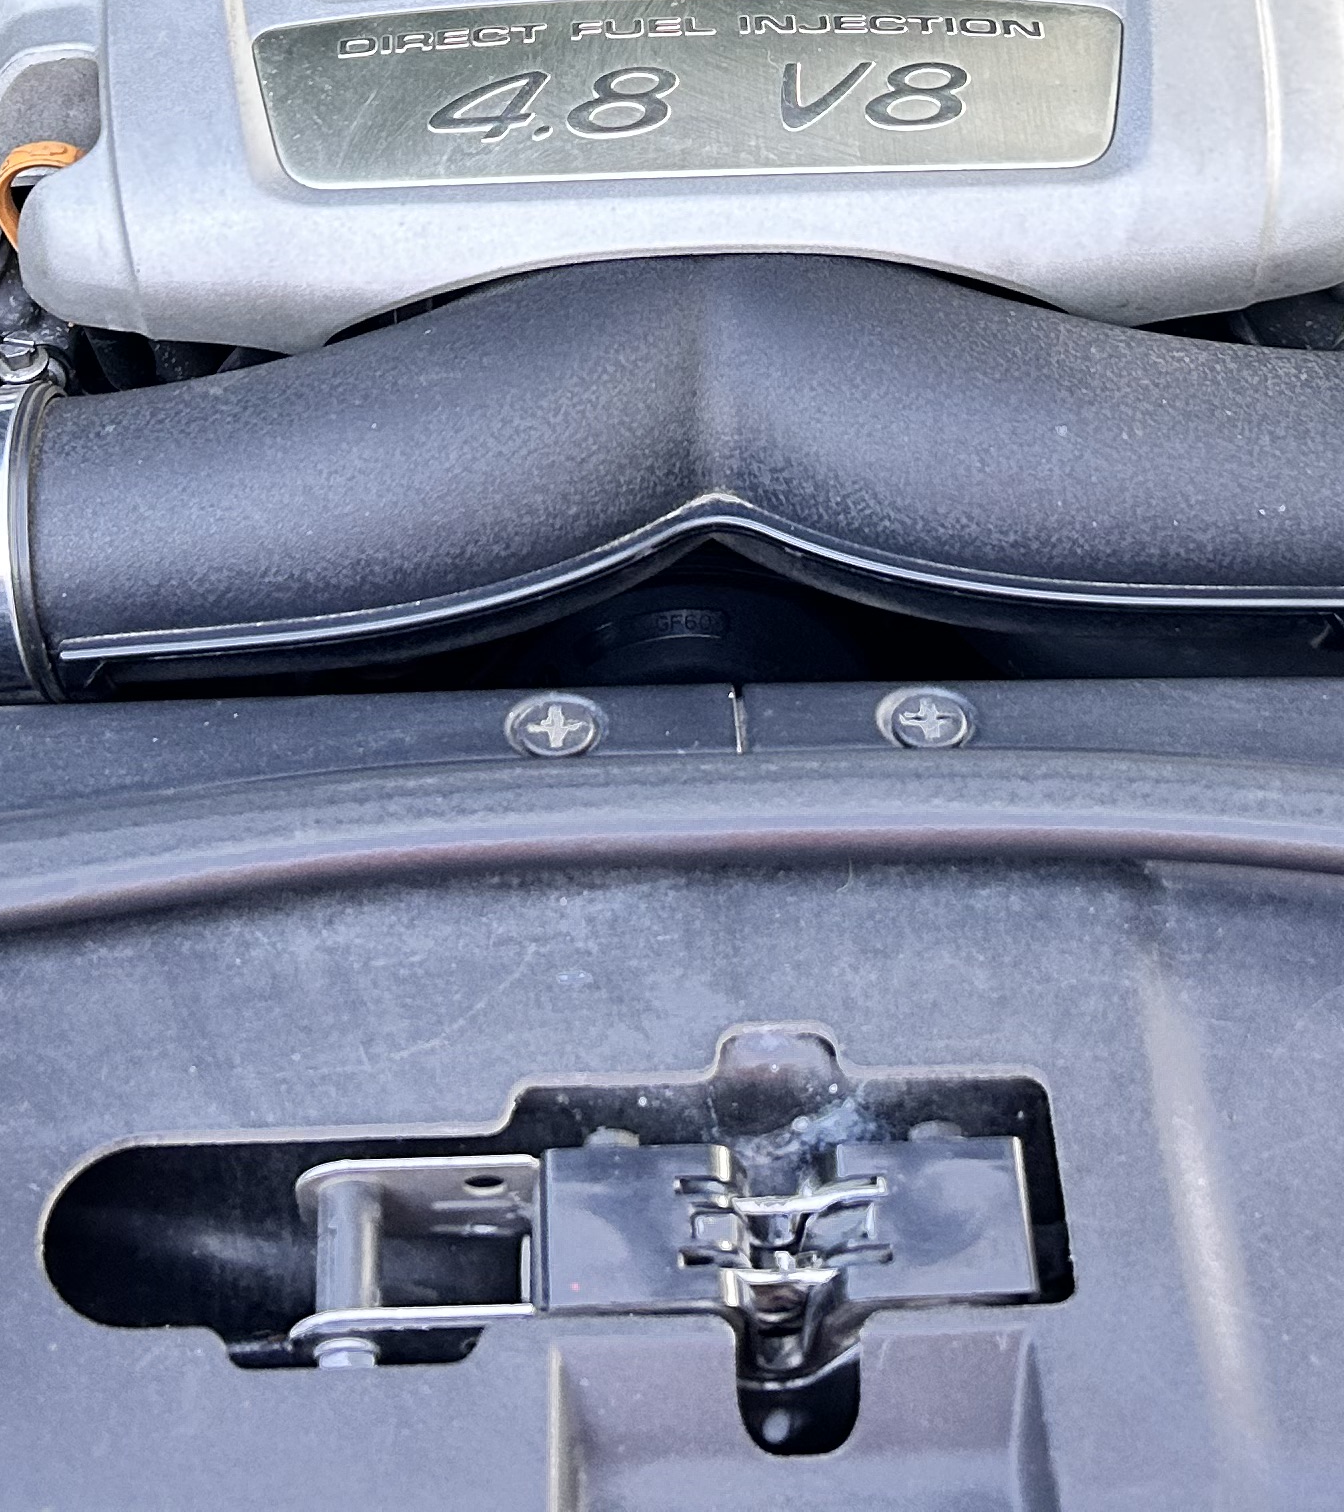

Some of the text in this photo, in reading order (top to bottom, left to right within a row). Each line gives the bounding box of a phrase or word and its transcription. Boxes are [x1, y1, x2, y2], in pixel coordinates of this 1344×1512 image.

[336, 14, 1045, 59] DIRECT FUEL INJECTION
[427, 60, 972, 144] 4.8 V8
